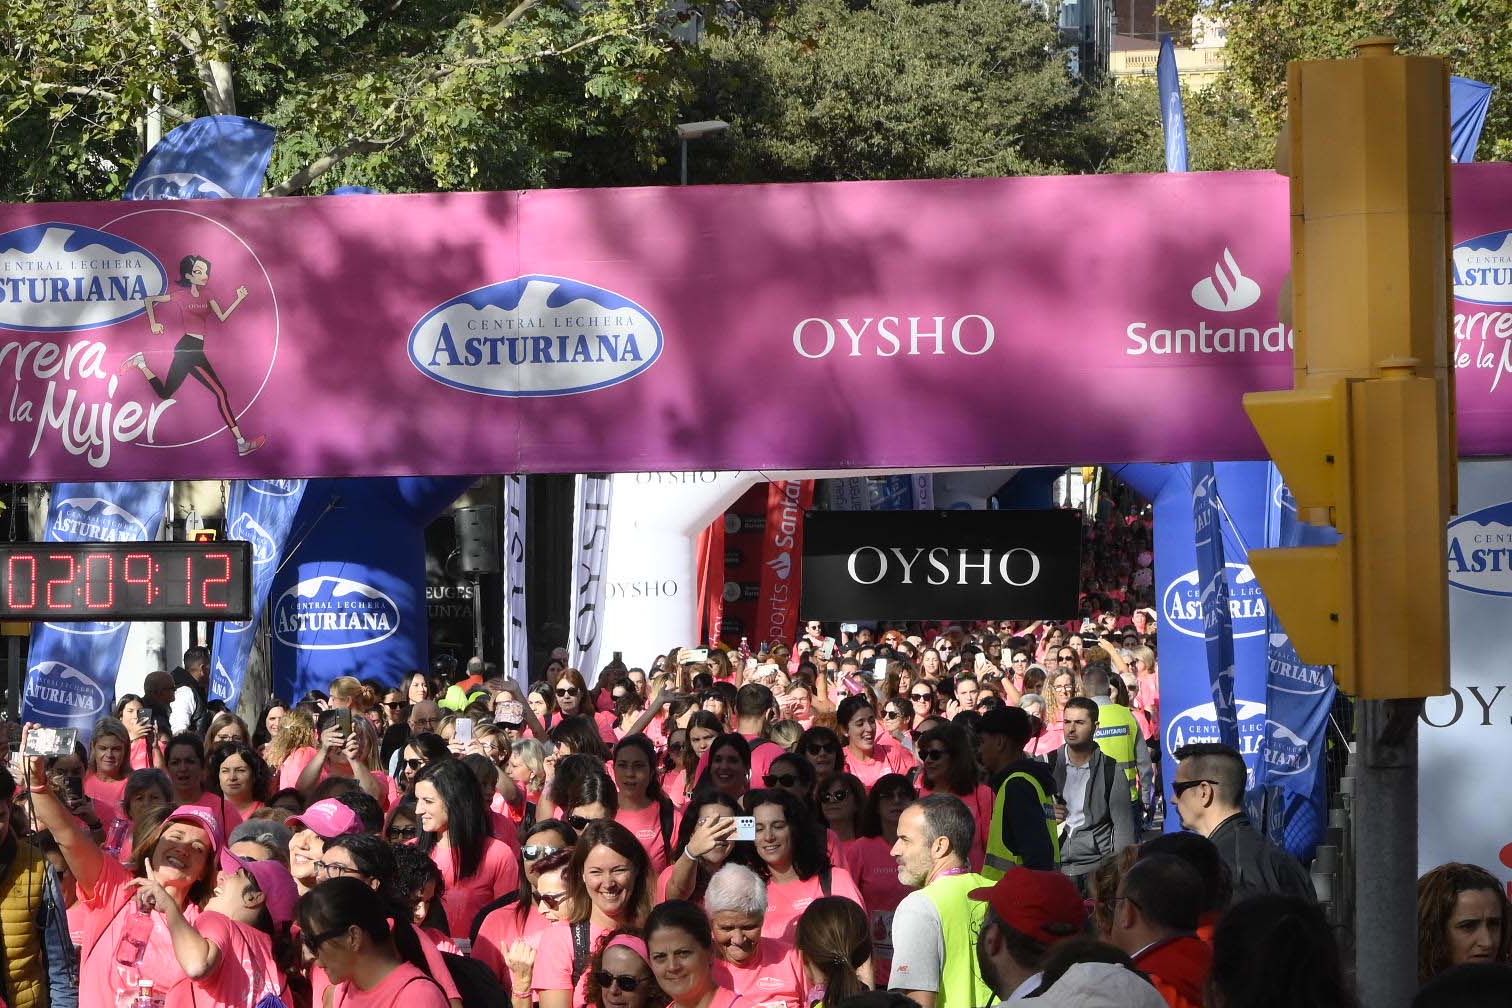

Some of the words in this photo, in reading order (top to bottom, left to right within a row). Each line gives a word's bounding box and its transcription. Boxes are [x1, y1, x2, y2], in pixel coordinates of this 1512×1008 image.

[71, 258, 142, 270] LECHERA
[467, 318, 545, 330] CENTRAL
[554, 315, 634, 328] LECHERA
[793, 313, 996, 359] OYSHO
[428, 322, 643, 366] ASTURIANA
[8, 383, 33, 422] la
[29, 374, 176, 468] Mujer
[847, 546, 1041, 587] OYSHO
[278, 607, 390, 633] ASTURIANA
